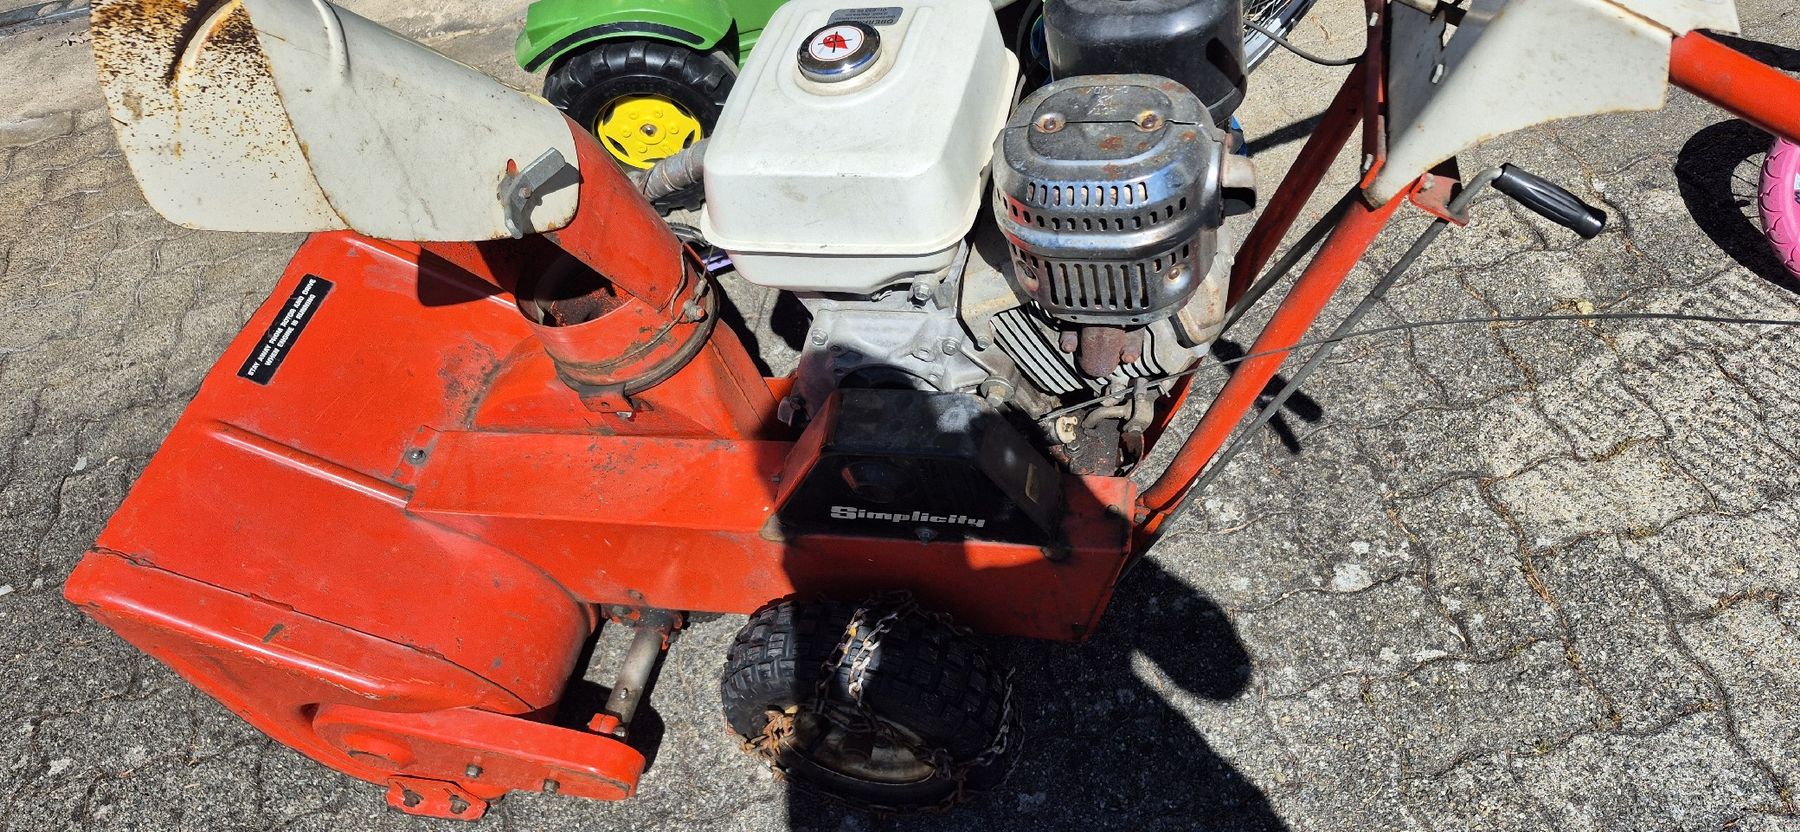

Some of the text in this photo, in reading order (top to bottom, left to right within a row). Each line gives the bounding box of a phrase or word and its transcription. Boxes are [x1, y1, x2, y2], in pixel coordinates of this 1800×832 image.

[247, 278, 317, 376] STAY AWAY FROM ROTOR AND DRIVE
[264, 293, 317, 366] WHEN ENGINE IS RUNNING
[830, 505, 986, 528] Simplicity
